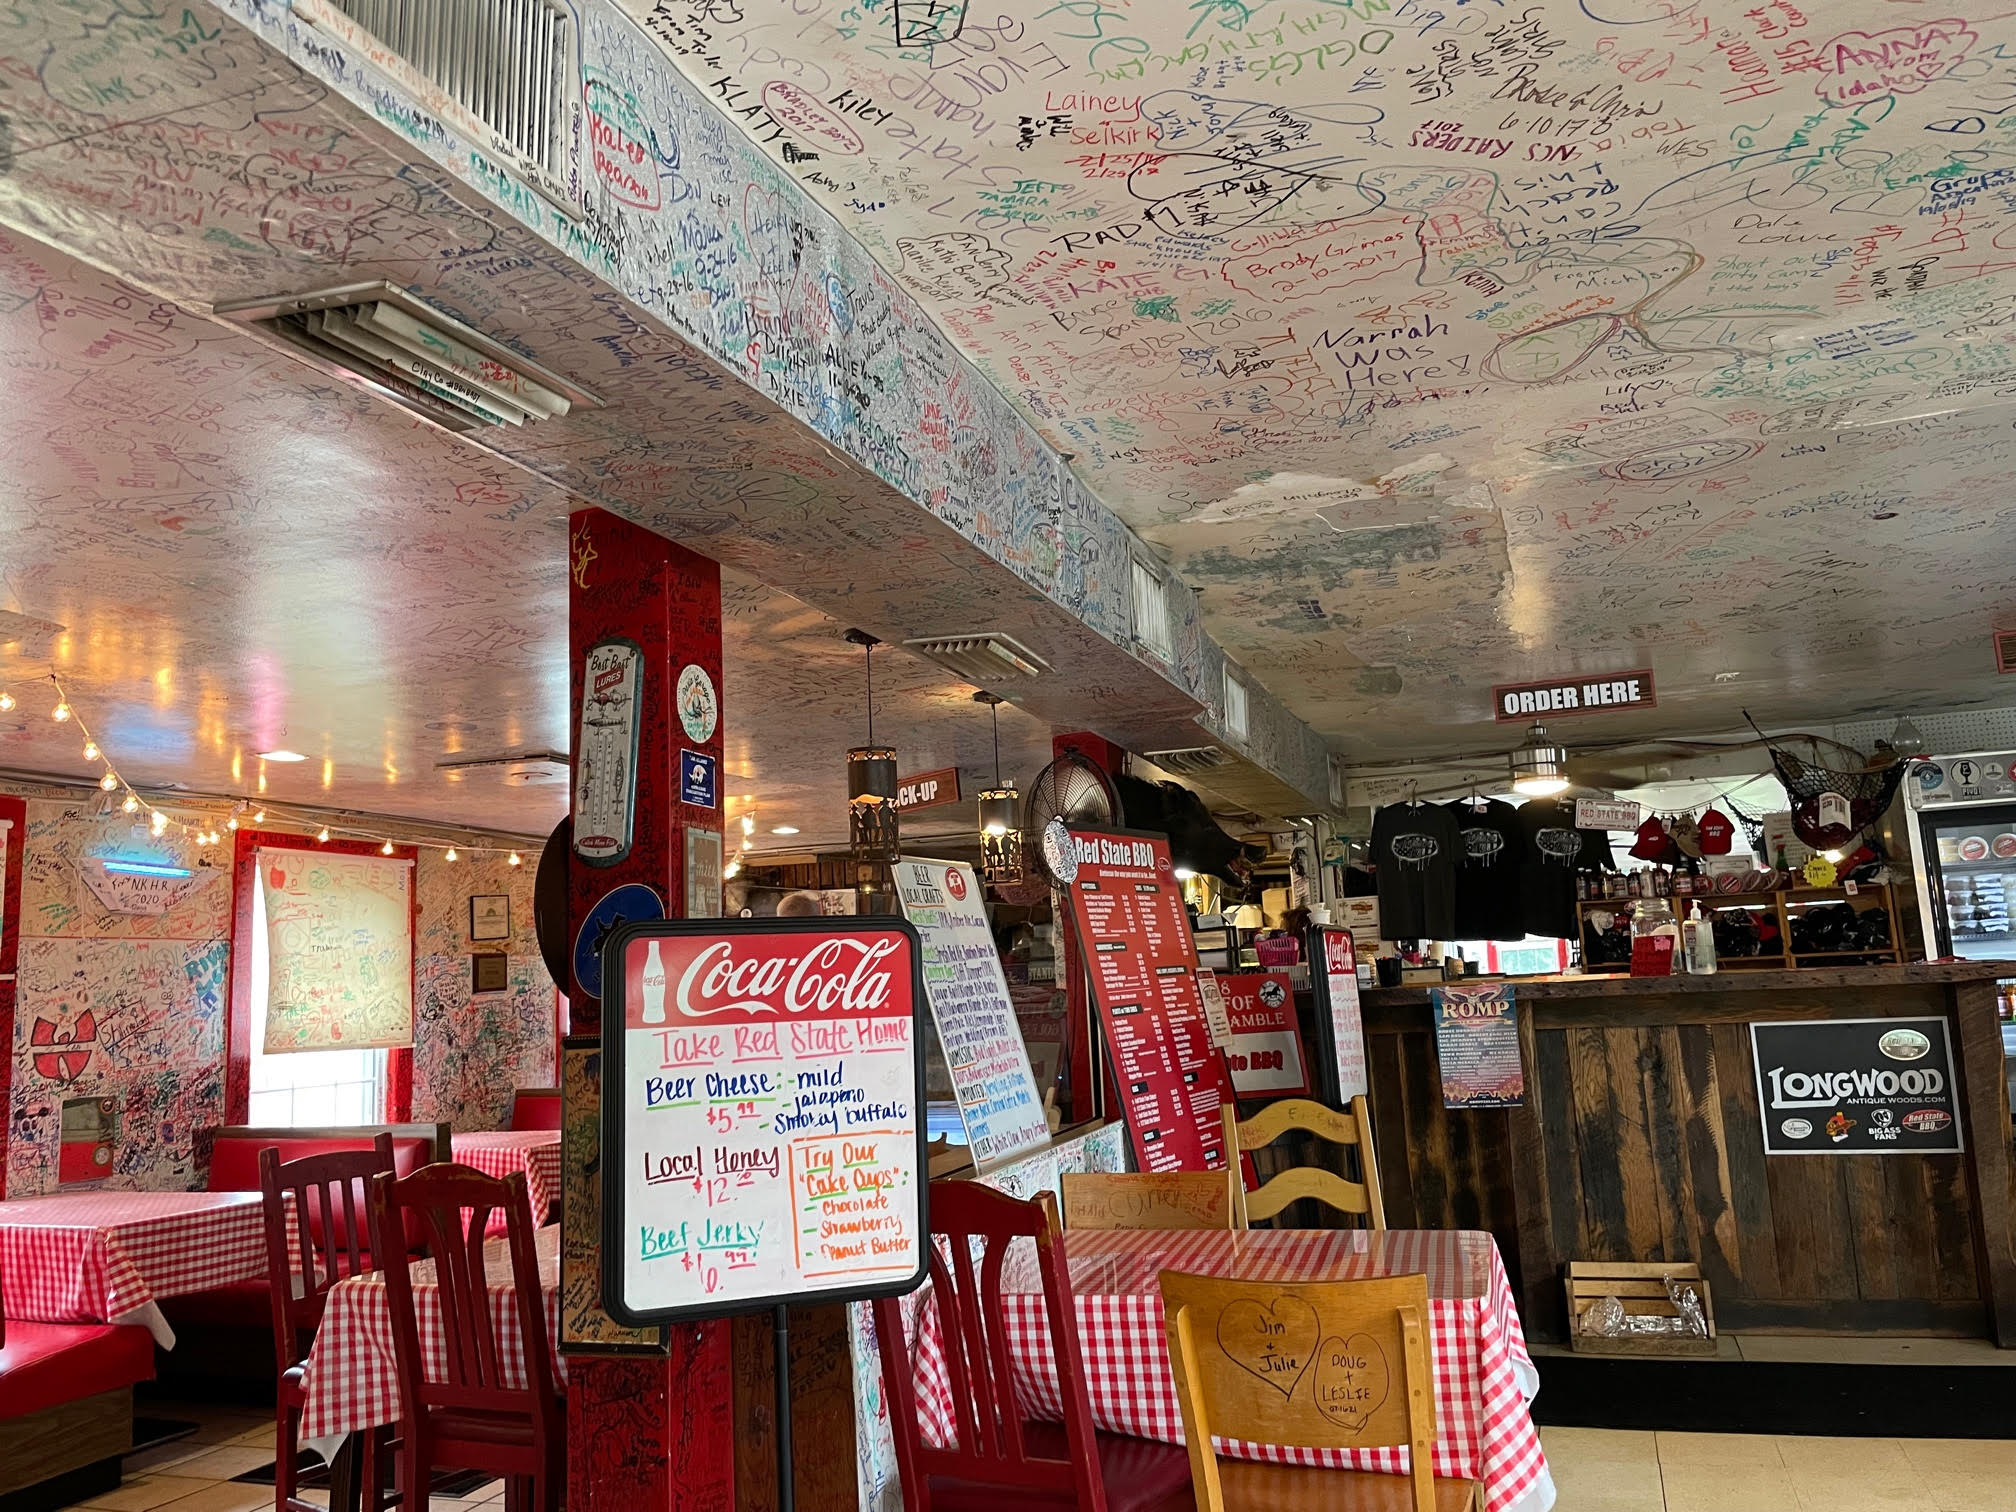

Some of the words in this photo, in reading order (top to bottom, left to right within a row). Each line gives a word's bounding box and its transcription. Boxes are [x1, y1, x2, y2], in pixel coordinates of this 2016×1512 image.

[1046, 91, 1142, 122] Lainey
[1408, 129, 1514, 159] RAIDERS
[1246, 248, 1318, 279] Brody
[1325, 231, 1405, 259] Grimes
[596, 671, 622, 688] LURES
[1504, 682, 1579, 715] ORDER
[1582, 680, 1641, 705] HERE
[900, 780, 938, 806] CK-UP
[1580, 809, 1595, 818] RED
[1596, 809, 1620, 819] STATE
[1075, 837, 1100, 864] Red
[1101, 838, 1131, 866] State
[1131, 842, 1156, 870] BBQ
[912, 865, 931, 883] BEER
[903, 887, 923, 904] LOCAL
[676, 937, 903, 1017] Coca-Cola
[1231, 1012, 1285, 1028] AMBLE
[1441, 1000, 1510, 1019] ROMP
[650, 1030, 724, 1066] Take
[733, 1023, 781, 1060] Red
[790, 1020, 854, 1056] State
[857, 1017, 909, 1050] Home
[1250, 1050, 1283, 1071] BBQ
[645, 1075, 696, 1106] Beer
[1768, 1066, 1944, 1110] LONGWOOD
[1887, 1096, 1946, 1104] WOODS.COM
[1908, 1112, 1923, 1122] Red
[1924, 1112, 1944, 1121] State
[1919, 1122, 1937, 1131] BBQ
[1868, 1127, 1885, 1135] BIG
[1874, 1133, 1898, 1141] FANS
[645, 1145, 702, 1182] Local
[713, 1147, 781, 1178] Honey
[800, 1144, 834, 1172] Try
[843, 1142, 879, 1167] Our
[822, 1195, 889, 1217] Chocolate
[640, 1225, 689, 1258] Beef
[697, 1219, 764, 1250] Jerky
[870, 1236, 913, 1257] Butter
[1251, 1313, 1287, 1337] Jim
[1258, 1352, 1300, 1374] Julie
[1330, 1352, 1368, 1370] DOUG
[1321, 1383, 1371, 1403] LESLIE
